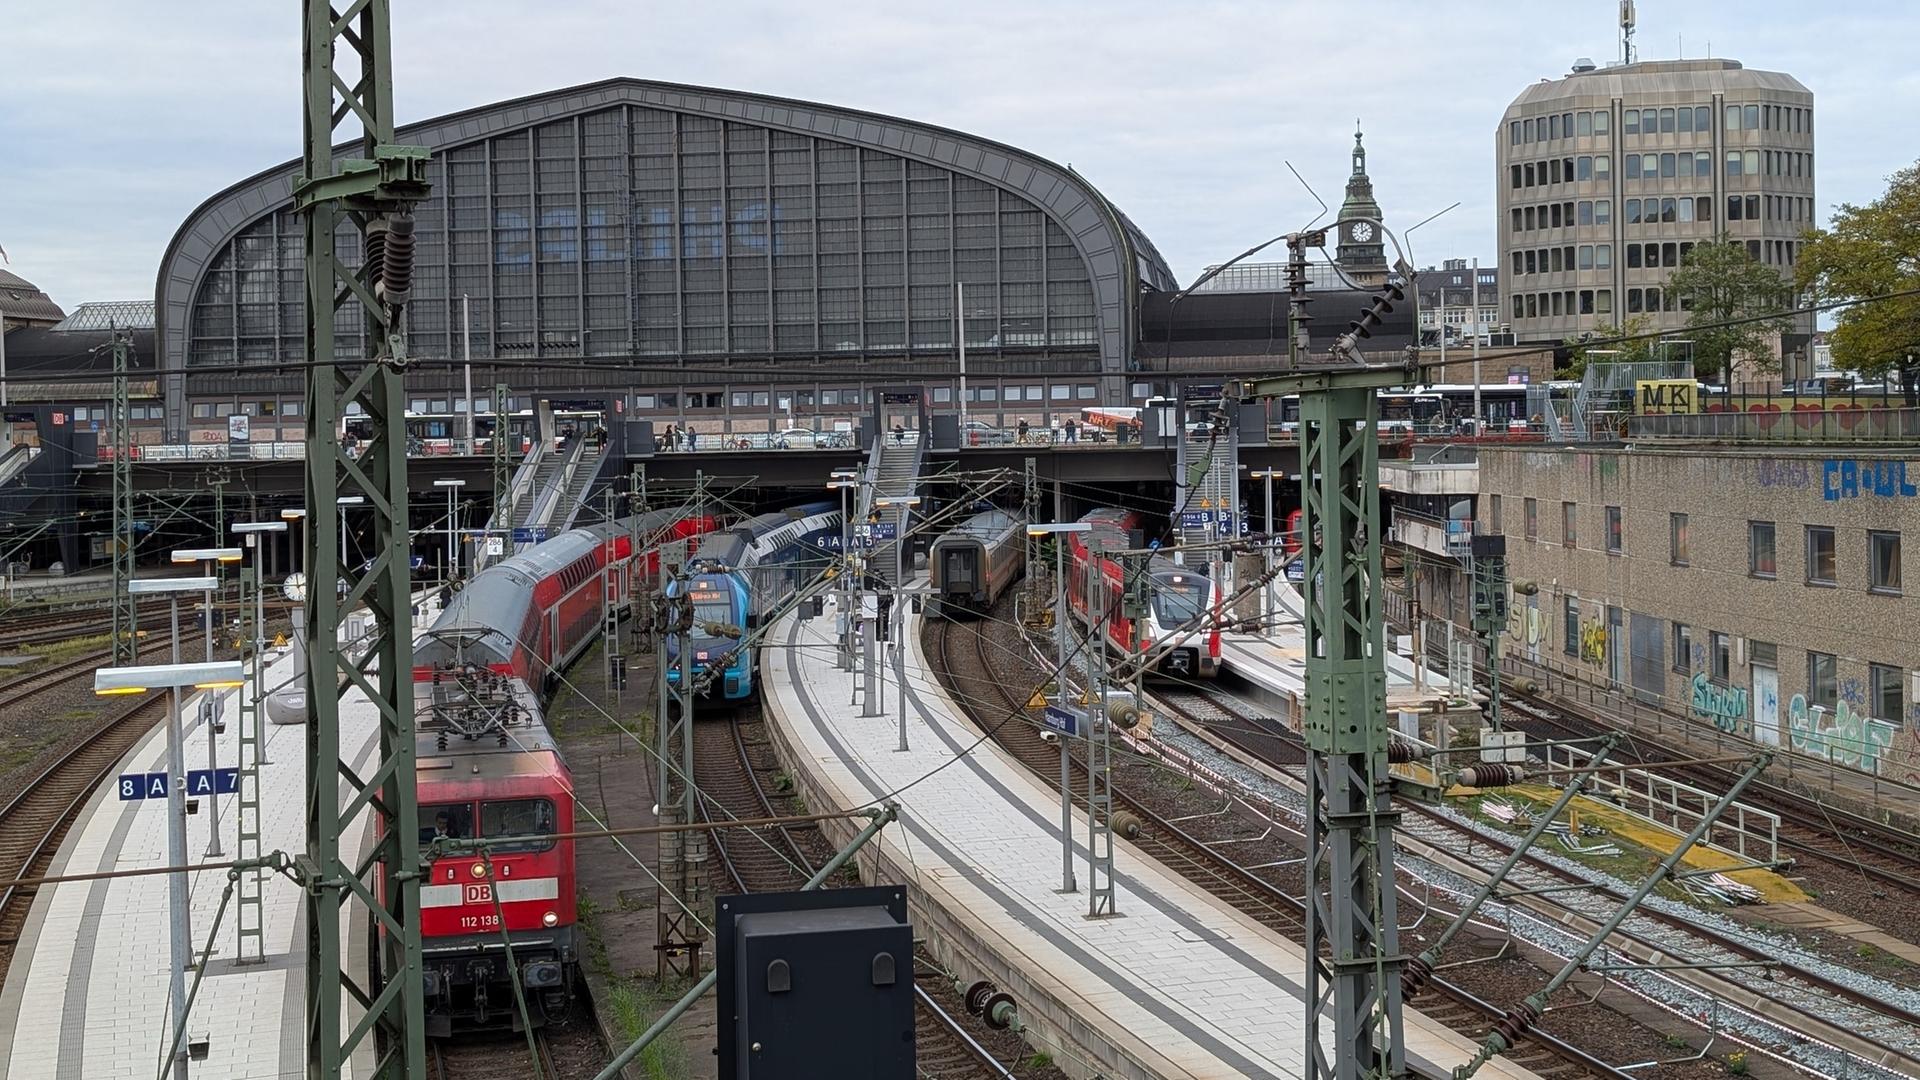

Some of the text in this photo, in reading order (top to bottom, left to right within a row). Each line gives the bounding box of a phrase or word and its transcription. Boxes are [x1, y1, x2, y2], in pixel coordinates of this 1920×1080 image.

[54, 414, 64, 423] DB
[1201, 512, 1209, 521] B
[1219, 512, 1227, 521] B
[1219, 523, 1226, 533] 4
[1241, 523, 1248, 533] 3
[817, 537, 825, 547] 6
[831, 537, 840, 547] A
[865, 536, 873, 547] 5
[415, 558, 423, 569] 7
[122, 773, 238, 796] 8 A A 7
[468, 887, 491, 900] DB
[462, 915, 498, 927] 112 138
